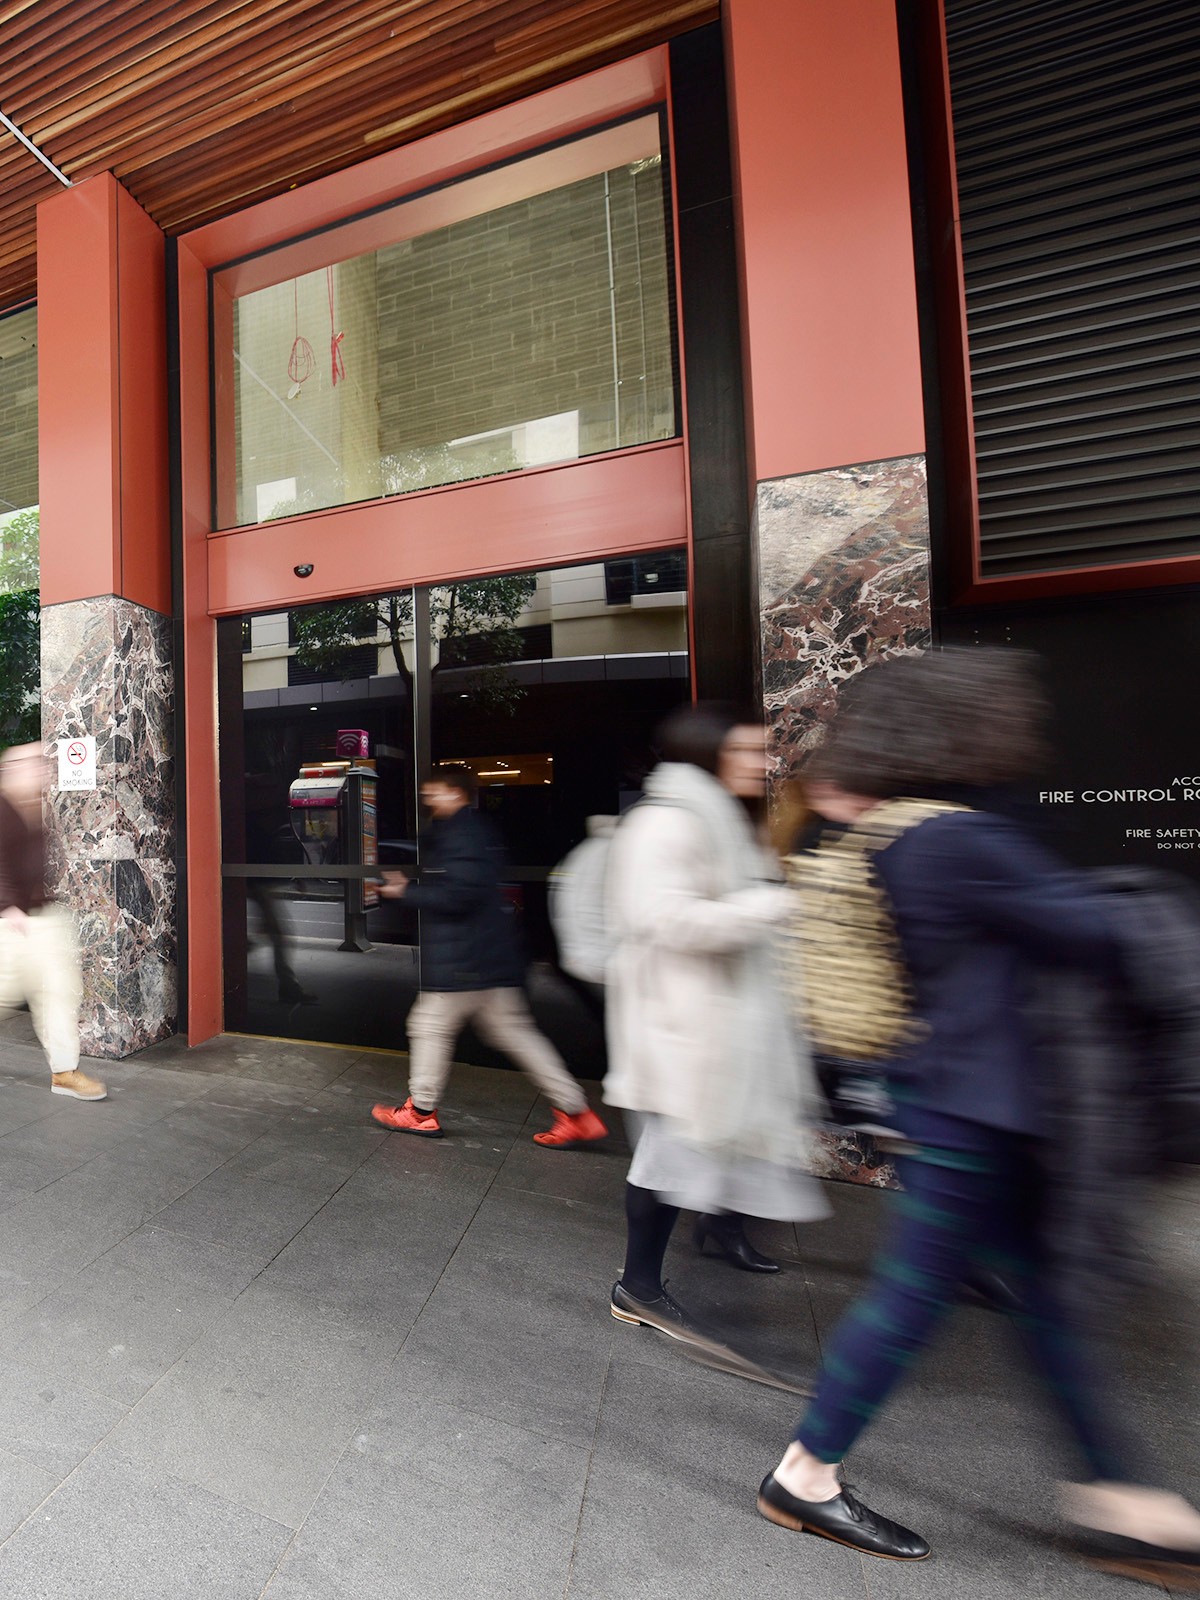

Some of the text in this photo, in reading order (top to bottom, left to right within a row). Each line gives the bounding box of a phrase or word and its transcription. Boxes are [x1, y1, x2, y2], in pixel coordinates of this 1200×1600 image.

[71, 769, 83, 777] NO
[62, 778, 94, 787] SMOKING
[1039, 790, 1075, 804] FIRE
[1081, 788, 1177, 803] CONTROL
[1125, 828, 1152, 838] FIRE
[1157, 842, 1172, 850] DO
[1174, 842, 1195, 850] NOT
